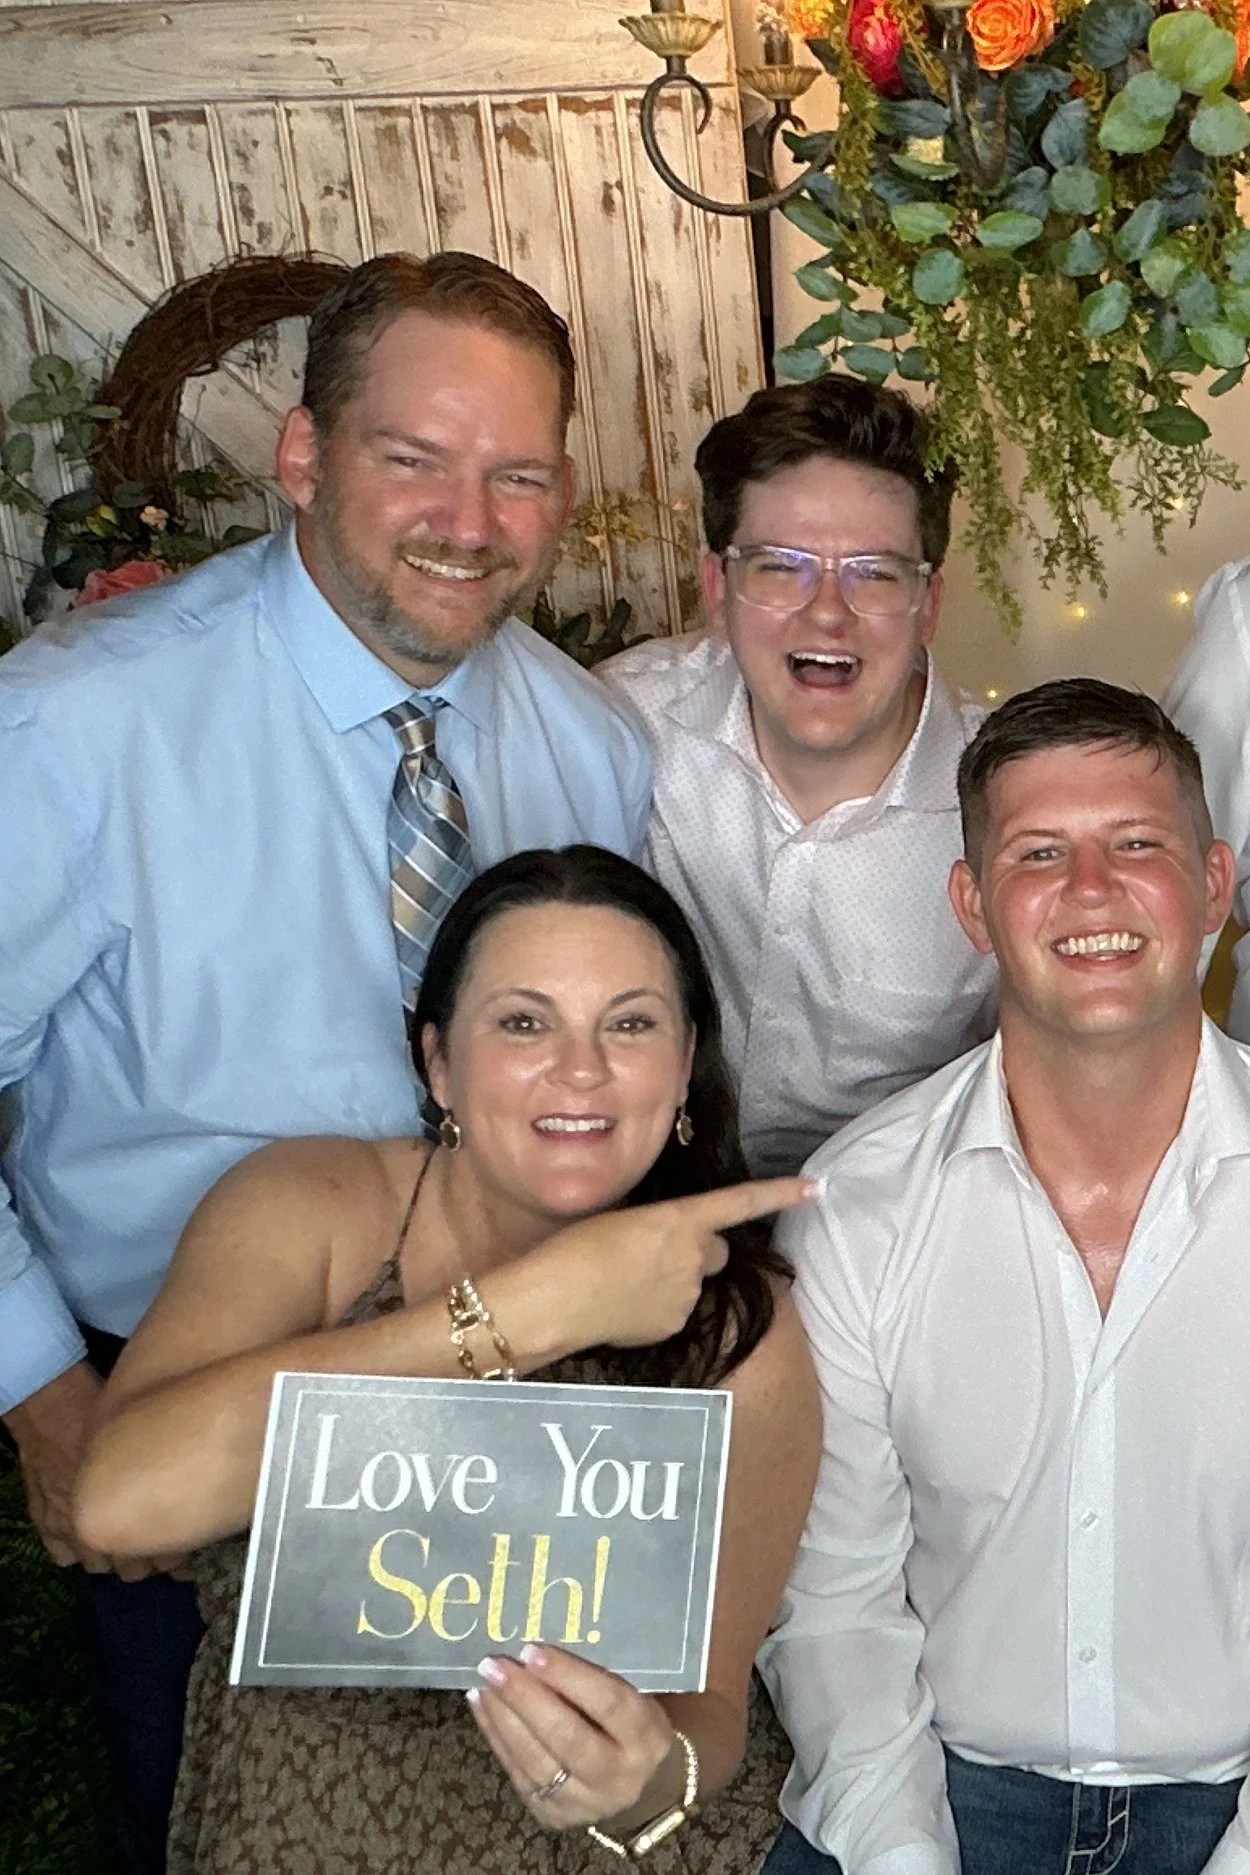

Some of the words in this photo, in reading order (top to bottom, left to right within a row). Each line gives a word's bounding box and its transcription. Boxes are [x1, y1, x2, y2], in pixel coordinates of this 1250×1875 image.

[305, 1413, 498, 1515] Love
[540, 1423, 685, 1521] You
[356, 1528, 611, 1644] Seth!
